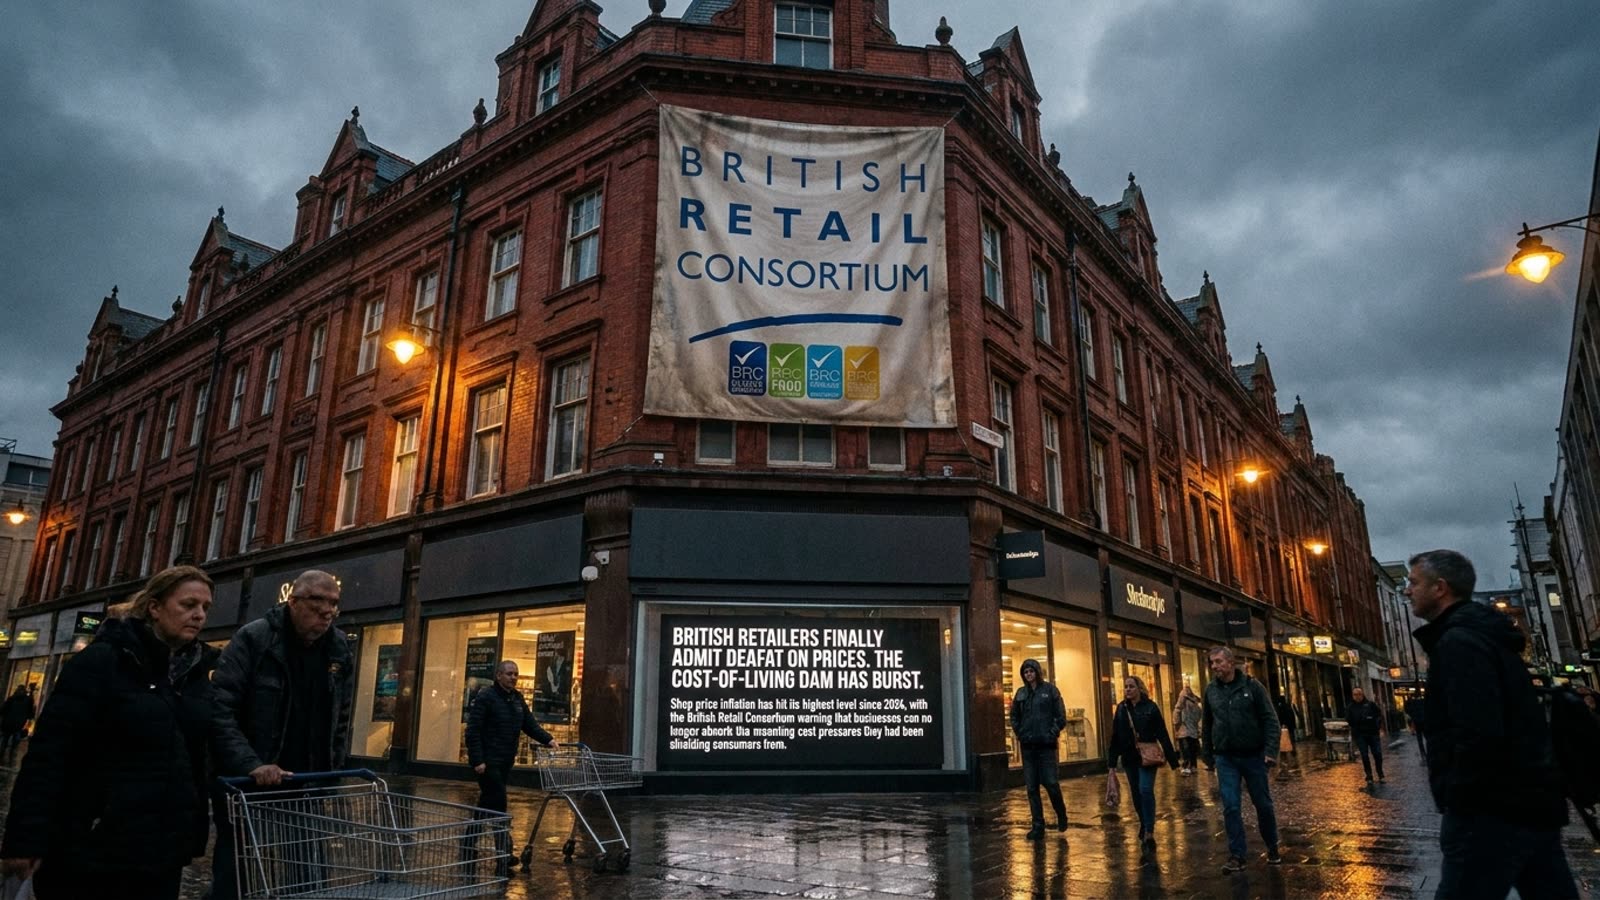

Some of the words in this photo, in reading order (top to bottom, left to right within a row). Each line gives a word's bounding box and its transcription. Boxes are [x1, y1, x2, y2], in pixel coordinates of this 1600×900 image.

[681, 146, 926, 193] BRITISH
[679, 197, 928, 244] RETAIL
[677, 251, 929, 292] CONSORTIUM
[732, 366, 764, 381] BRC
[809, 369, 841, 382] BRC
[673, 626, 734, 647] BRITISH
[738, 627, 820, 648] RETAILERS
[823, 628, 884, 648] FINALLY
[671, 647, 723, 668] ADMIT
[726, 648, 785, 668] DEAFAT
[787, 648, 809, 668] ON
[812, 649, 871, 669] PRICES.
[874, 649, 904, 669] THE
[671, 668, 795, 689] COST-OF-LIVING
[799, 670, 834, 689] DAM
[838, 670, 869, 690] HAS
[872, 670, 925, 690] BURST.
[695, 698, 719, 711] price
[758, 698, 774, 710] has
[775, 698, 788, 710] hit
[859, 698, 882, 710] since
[909, 698, 928, 710] with
[669, 711, 685, 723] the
[797, 712, 833, 726] warning
[921, 714, 933, 723] no
[884, 725, 900, 737] had
[902, 725, 924, 737] been
